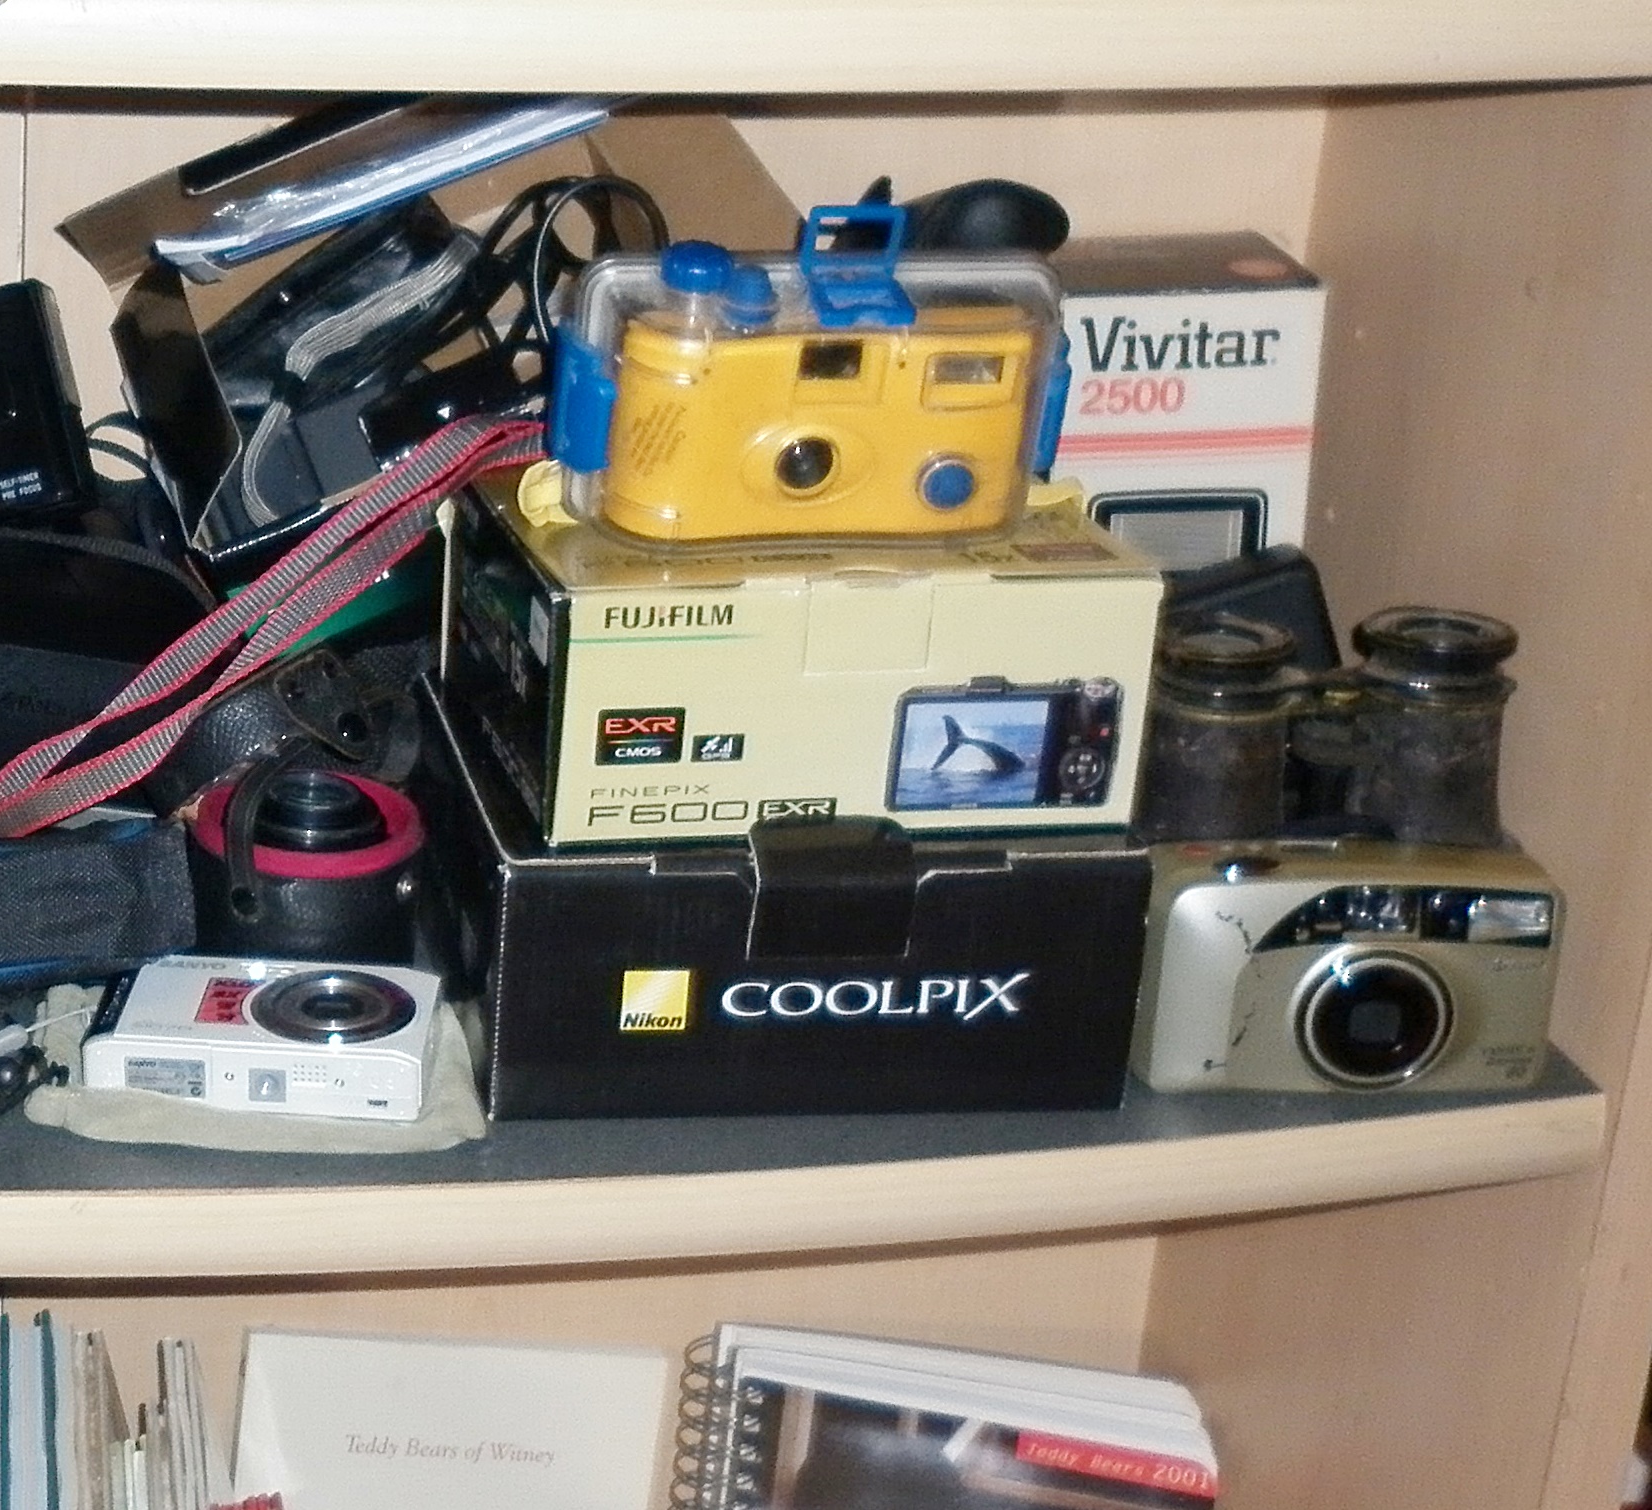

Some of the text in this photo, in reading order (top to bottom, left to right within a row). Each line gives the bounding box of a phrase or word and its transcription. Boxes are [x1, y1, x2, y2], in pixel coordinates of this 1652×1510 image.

[1080, 315, 1281, 372] Vivitar
[1078, 376, 1187, 415] 2500
[19, 482, 42, 497] FOCUS
[604, 603, 735, 629] FUJIFILM
[605, 716, 677, 735] EXR
[614, 746, 663, 758] CMOS
[590, 783, 711, 799] FINEPIX
[587, 799, 831, 827] F600 EXR
[721, 972, 1031, 1021] COOLPIX
[622, 1011, 684, 1029] Nikon
[345, 1434, 556, 1468] Teddy Bears of Witney
[1024, 1442, 1211, 1490] Teddy Bears 2001
